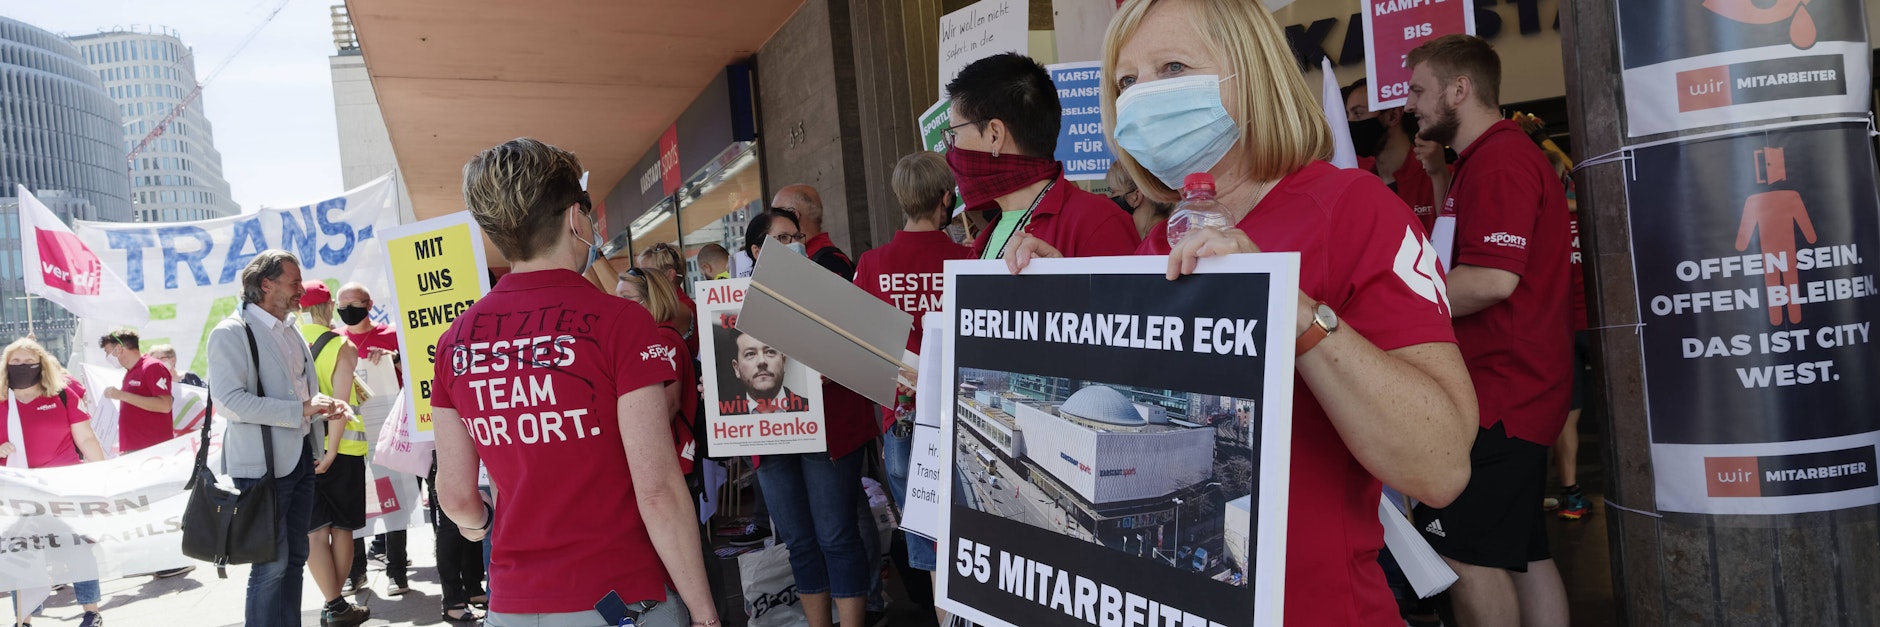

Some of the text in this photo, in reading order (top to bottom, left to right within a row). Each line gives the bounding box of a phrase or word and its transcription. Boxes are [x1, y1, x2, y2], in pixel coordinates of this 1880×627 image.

[942, 18, 956, 42] Wir
[988, 2, 1009, 22] nicht
[1404, 22, 1433, 40] BIS
[970, 41, 977, 51] in
[980, 30, 994, 46] die
[1689, 69, 1837, 96] wir MITARBEITER
[1074, 138, 1102, 152] FÜR
[1066, 159, 1111, 171] UNS!!!
[106, 196, 374, 292] TRANS-
[414, 236, 443, 260] MIT
[1490, 234, 1527, 246] SPORTS
[42, 260, 95, 288] ver.di
[1675, 243, 1863, 282] OFFEN SEIN.
[417, 268, 453, 292] UNS
[890, 293, 943, 312] TEAM
[1650, 274, 1878, 316] OFFEN BLEIBEN.
[454, 302, 600, 344] LETZTES
[960, 308, 1258, 357] BERLIN KRANZLER ECK
[1681, 321, 1870, 359] DAS IST CITY
[453, 335, 577, 377] BESTES
[1735, 360, 1840, 389] WEST.
[469, 374, 557, 412] TEAM
[719, 392, 809, 414] wir auch,
[461, 408, 601, 447] VOR ORT.
[713, 417, 818, 439] Herr Benko
[1718, 461, 1868, 483] wir MITARBEITER
[0, 494, 150, 518] DERN
[956, 536, 991, 584] 55
